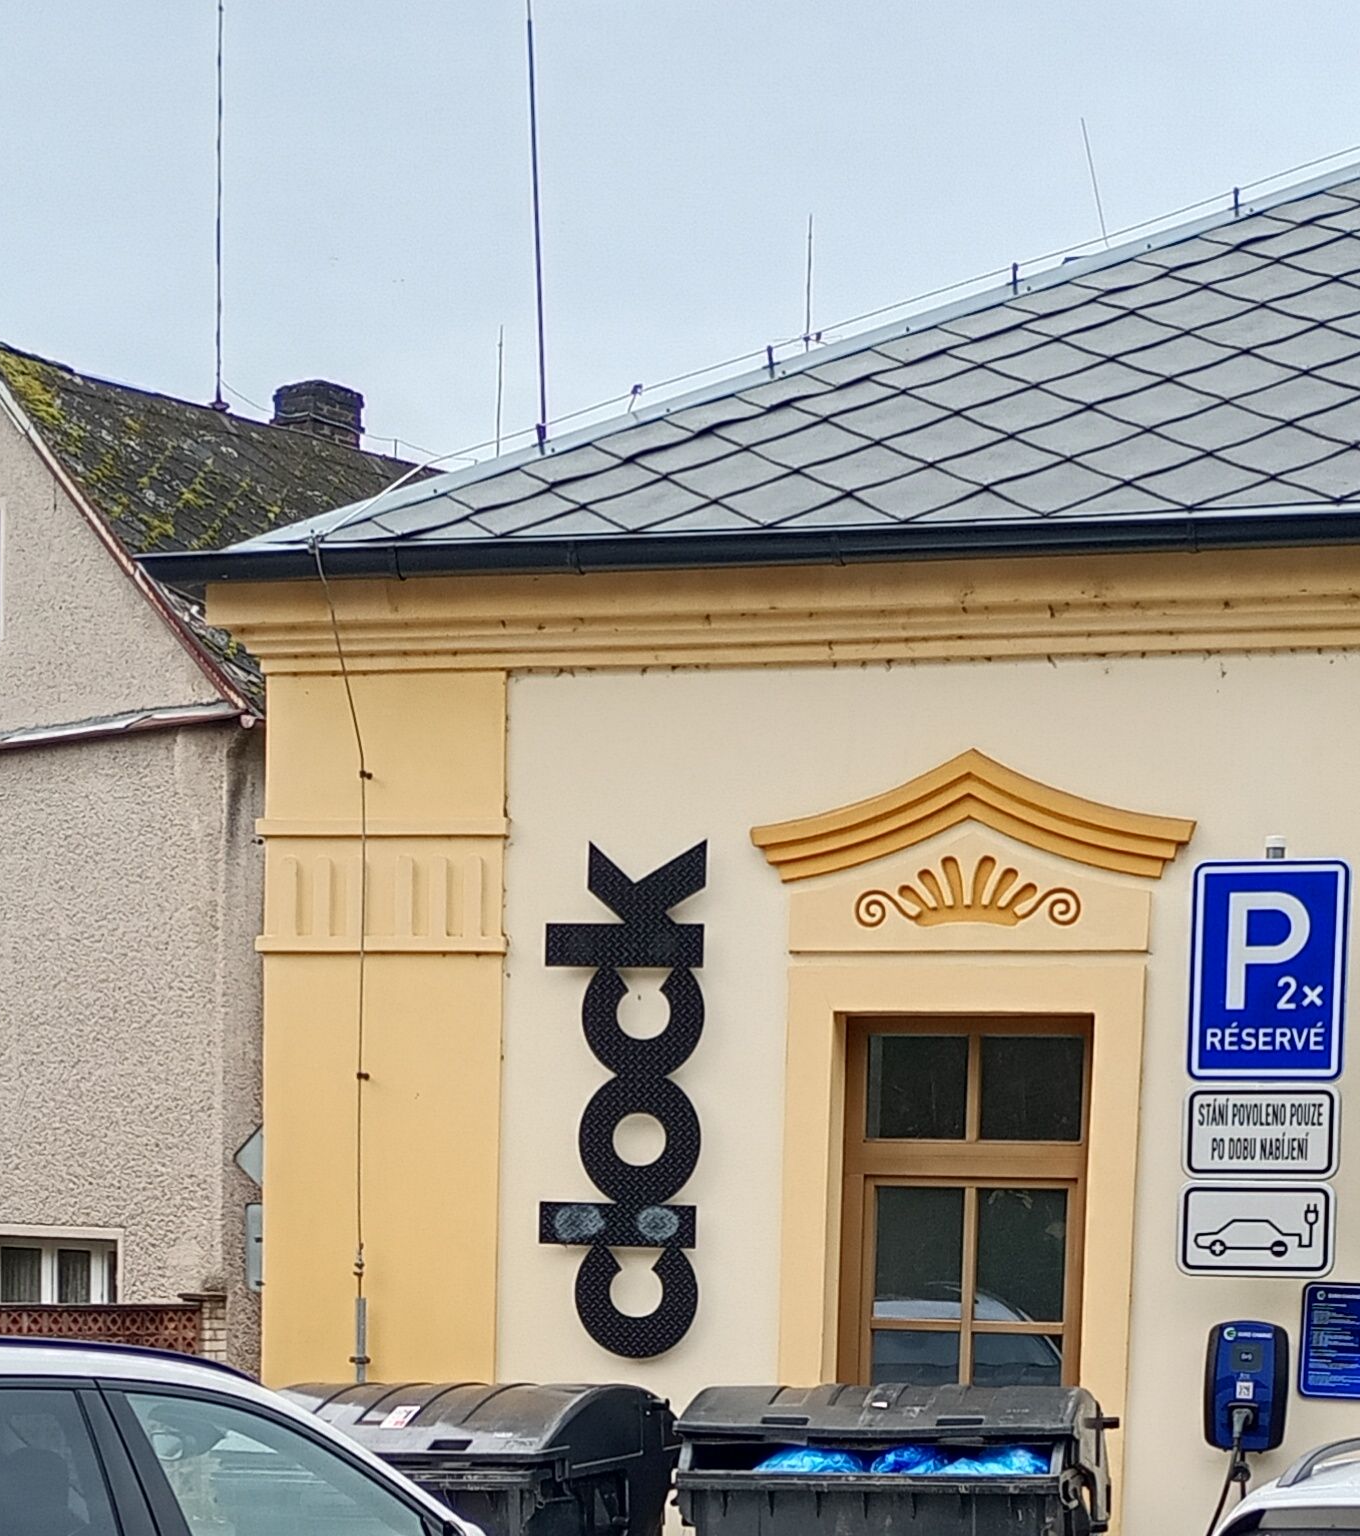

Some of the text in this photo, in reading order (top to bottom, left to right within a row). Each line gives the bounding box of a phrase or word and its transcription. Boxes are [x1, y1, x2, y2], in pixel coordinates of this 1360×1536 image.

[1225, 891, 1311, 1010] P
[1206, 1021, 1325, 1051] RÉSERVÉ
[1198, 1098, 1324, 1127] STÁNÍ POVOLENO POUZE
[1211, 1132, 1310, 1161] PO DOBU NABÍJENÍ
